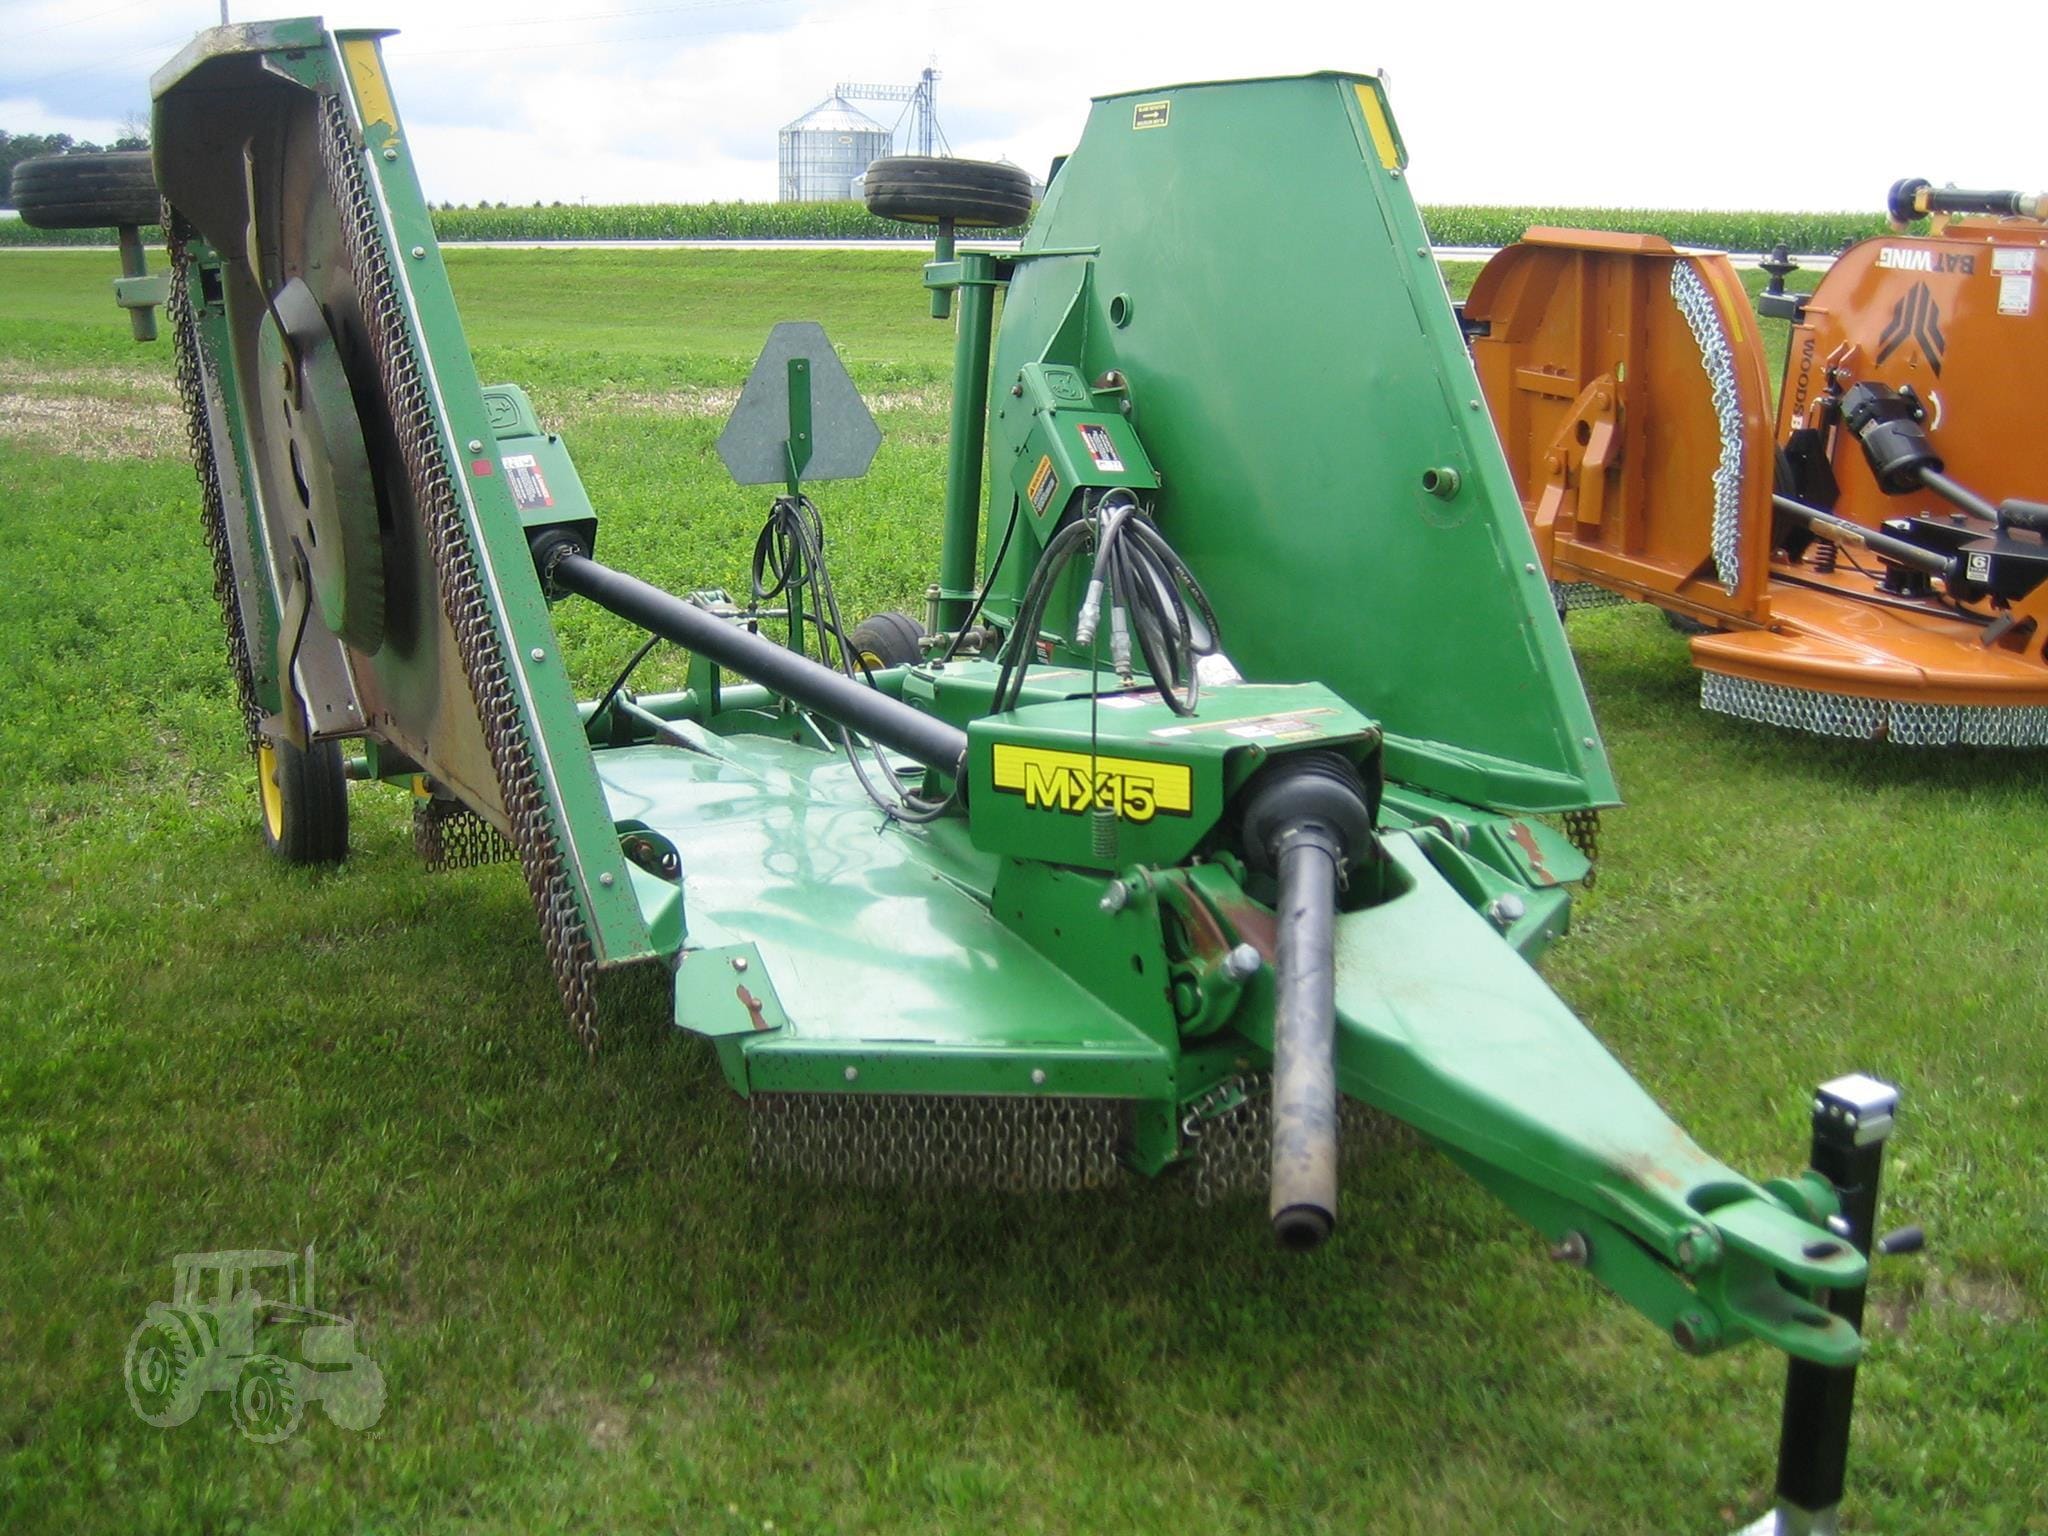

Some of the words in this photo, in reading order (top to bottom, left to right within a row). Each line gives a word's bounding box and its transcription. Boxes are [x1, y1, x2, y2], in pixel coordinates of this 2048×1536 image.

[1793, 340, 1815, 415] WOODS
[1972, 556, 1986, 568] 6
[1025, 763, 1155, 822] MX15
